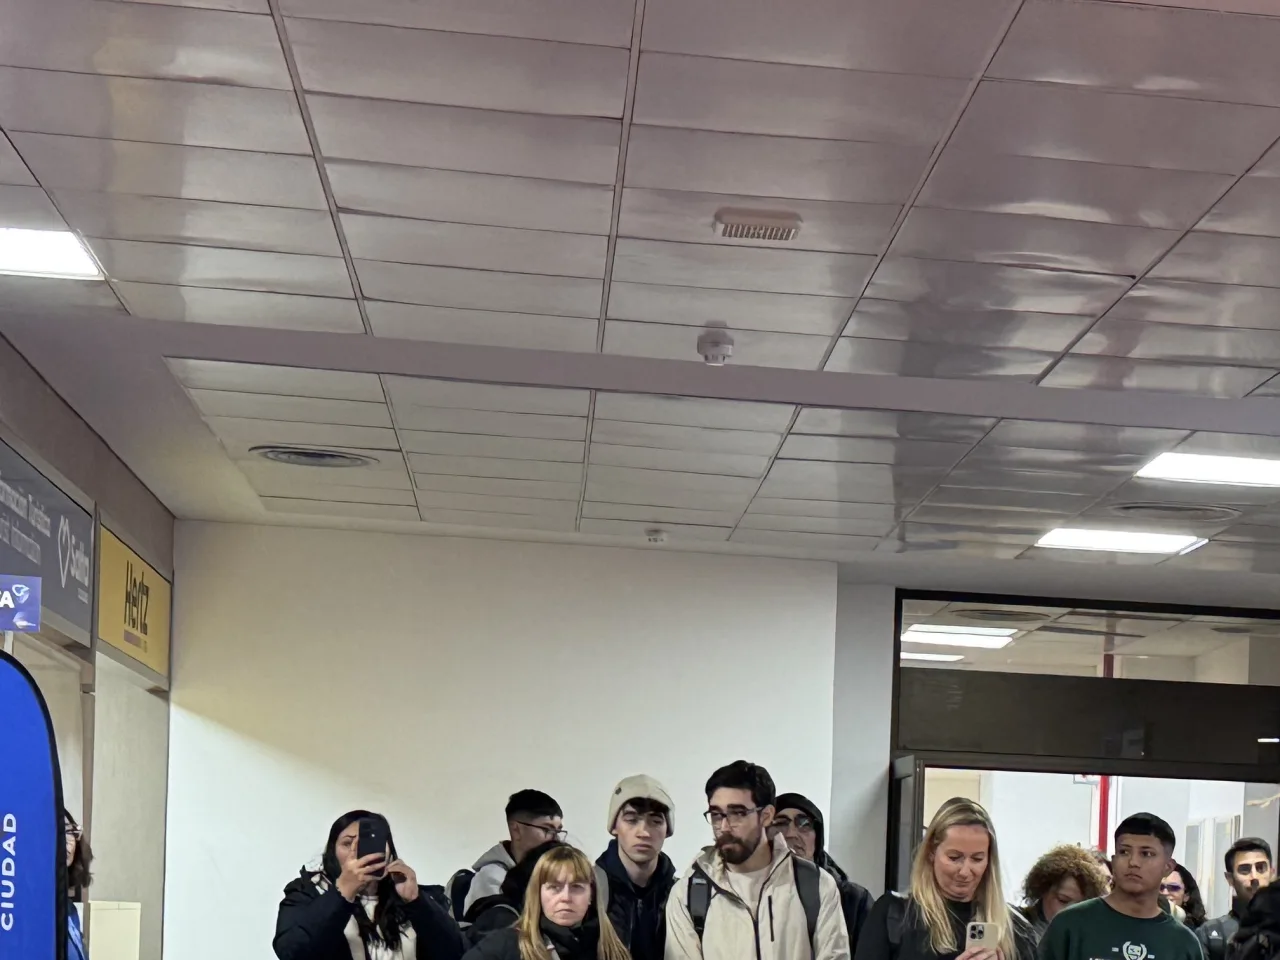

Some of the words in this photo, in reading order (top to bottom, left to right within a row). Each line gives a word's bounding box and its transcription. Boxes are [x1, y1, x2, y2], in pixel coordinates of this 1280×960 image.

[0, 590, 15, 608] A
[124, 560, 149, 635] Hertz
[1, 813, 17, 931] CIUDAD
